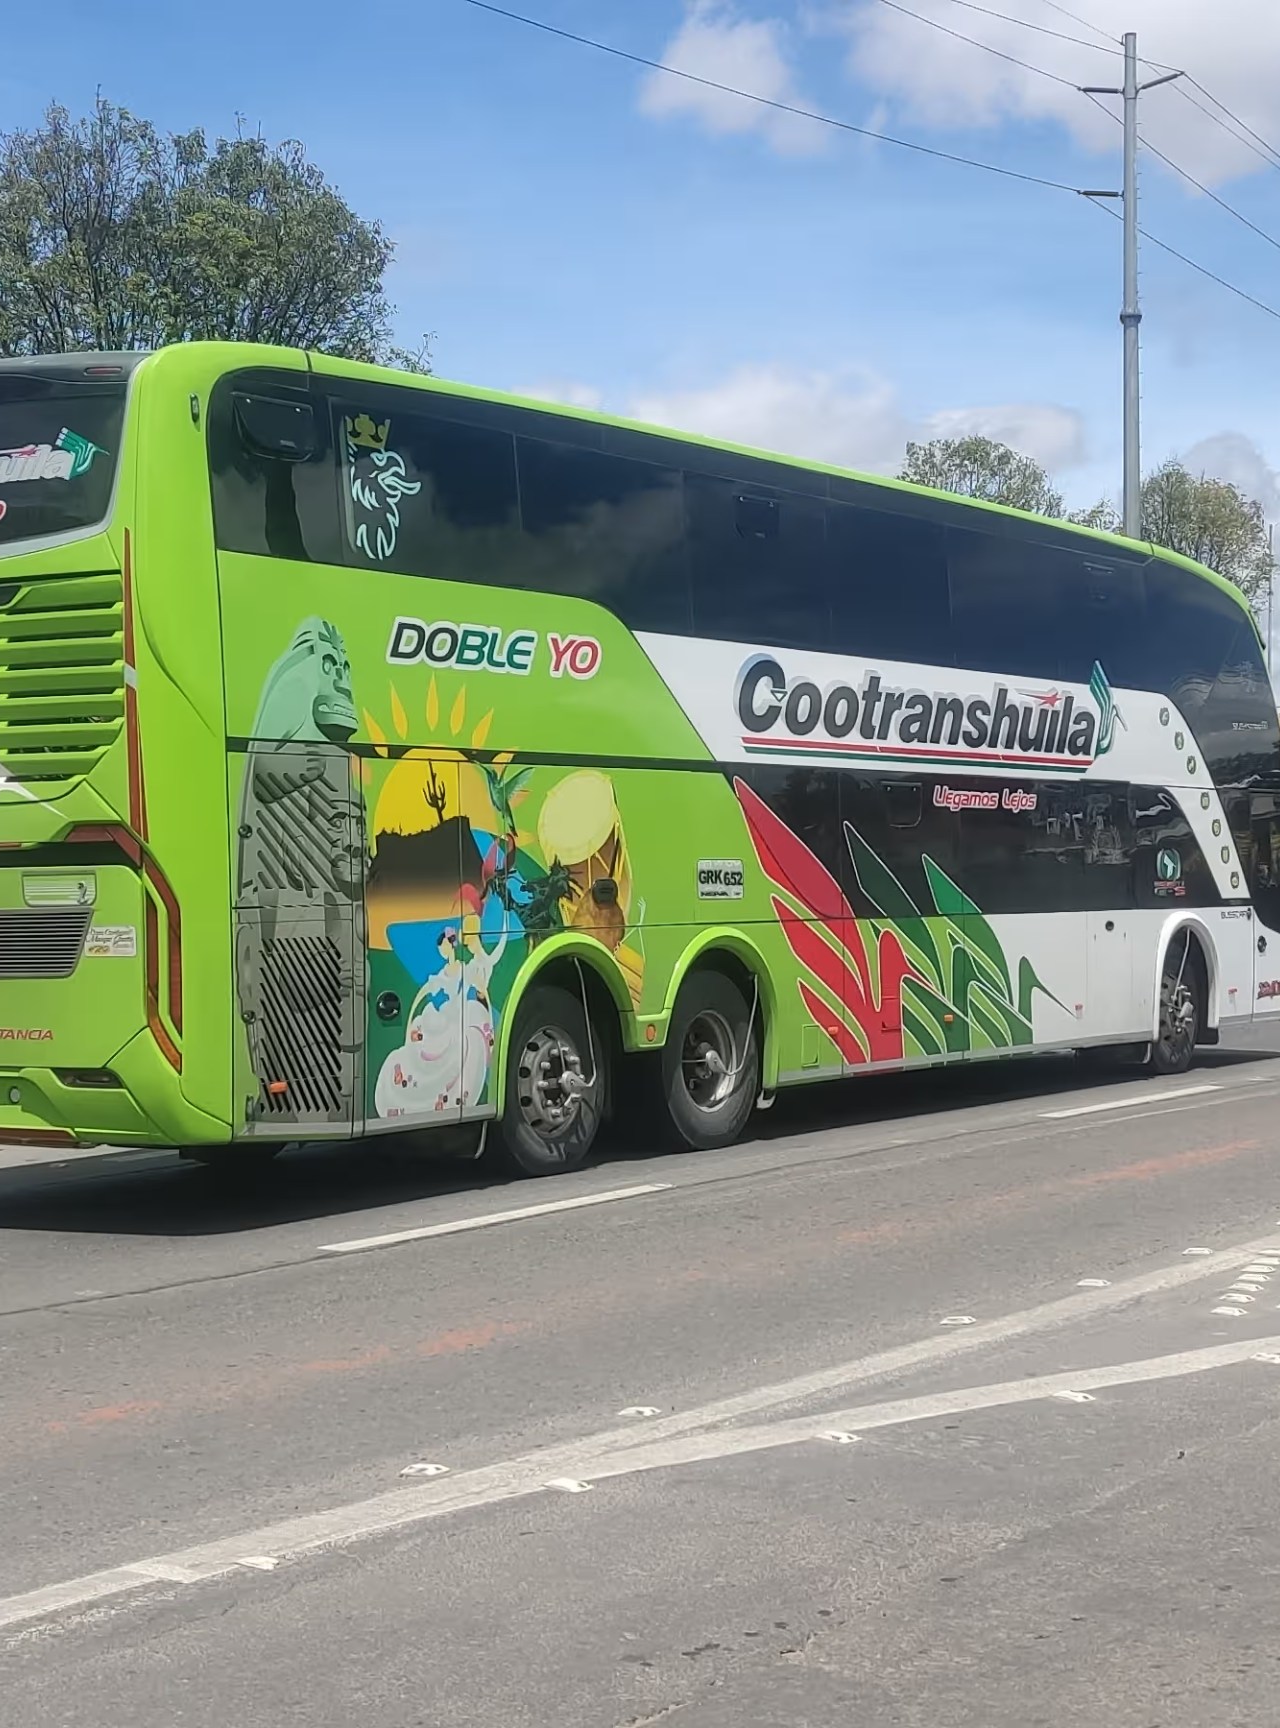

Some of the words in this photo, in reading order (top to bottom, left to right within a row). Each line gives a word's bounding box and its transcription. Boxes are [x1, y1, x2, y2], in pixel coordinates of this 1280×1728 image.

[387, 617, 536, 672] DOBLE
[548, 633, 603, 679] YO
[735, 655, 1097, 757] Cootranshuila
[933, 784, 999, 812] Llegamos
[1002, 788, 1037, 813] Lejos
